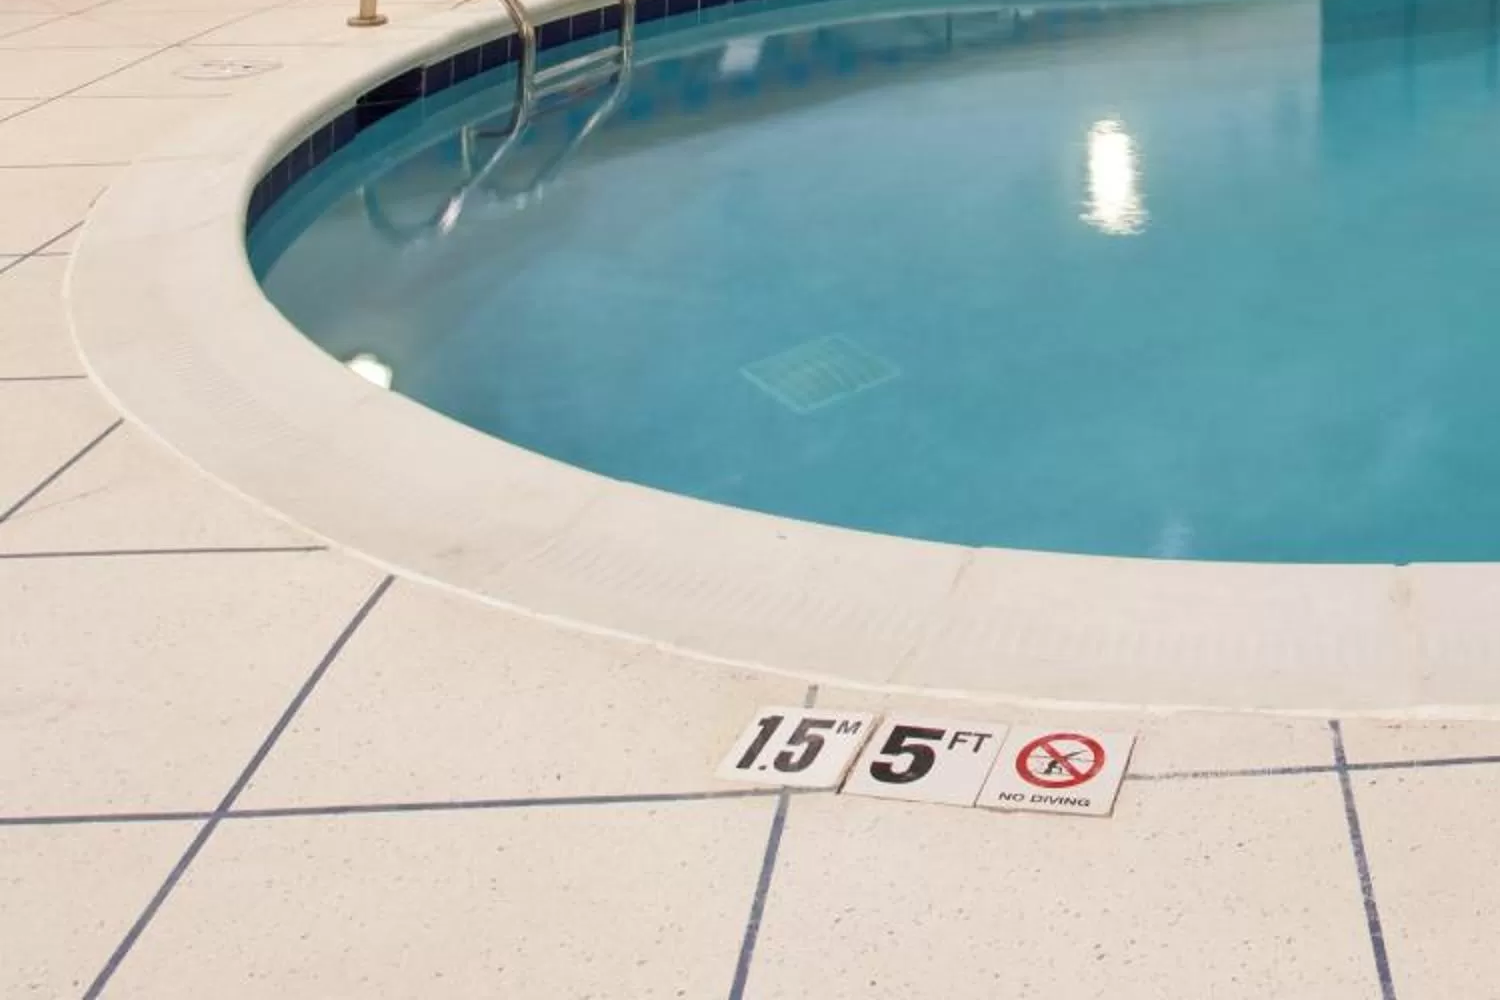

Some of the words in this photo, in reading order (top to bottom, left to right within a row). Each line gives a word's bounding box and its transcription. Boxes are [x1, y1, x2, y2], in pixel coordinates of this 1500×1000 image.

[869, 725, 946, 784] 5
[947, 731, 992, 753] FT
[998, 791, 1025, 802] NO
[1030, 794, 1091, 807] DIVING
